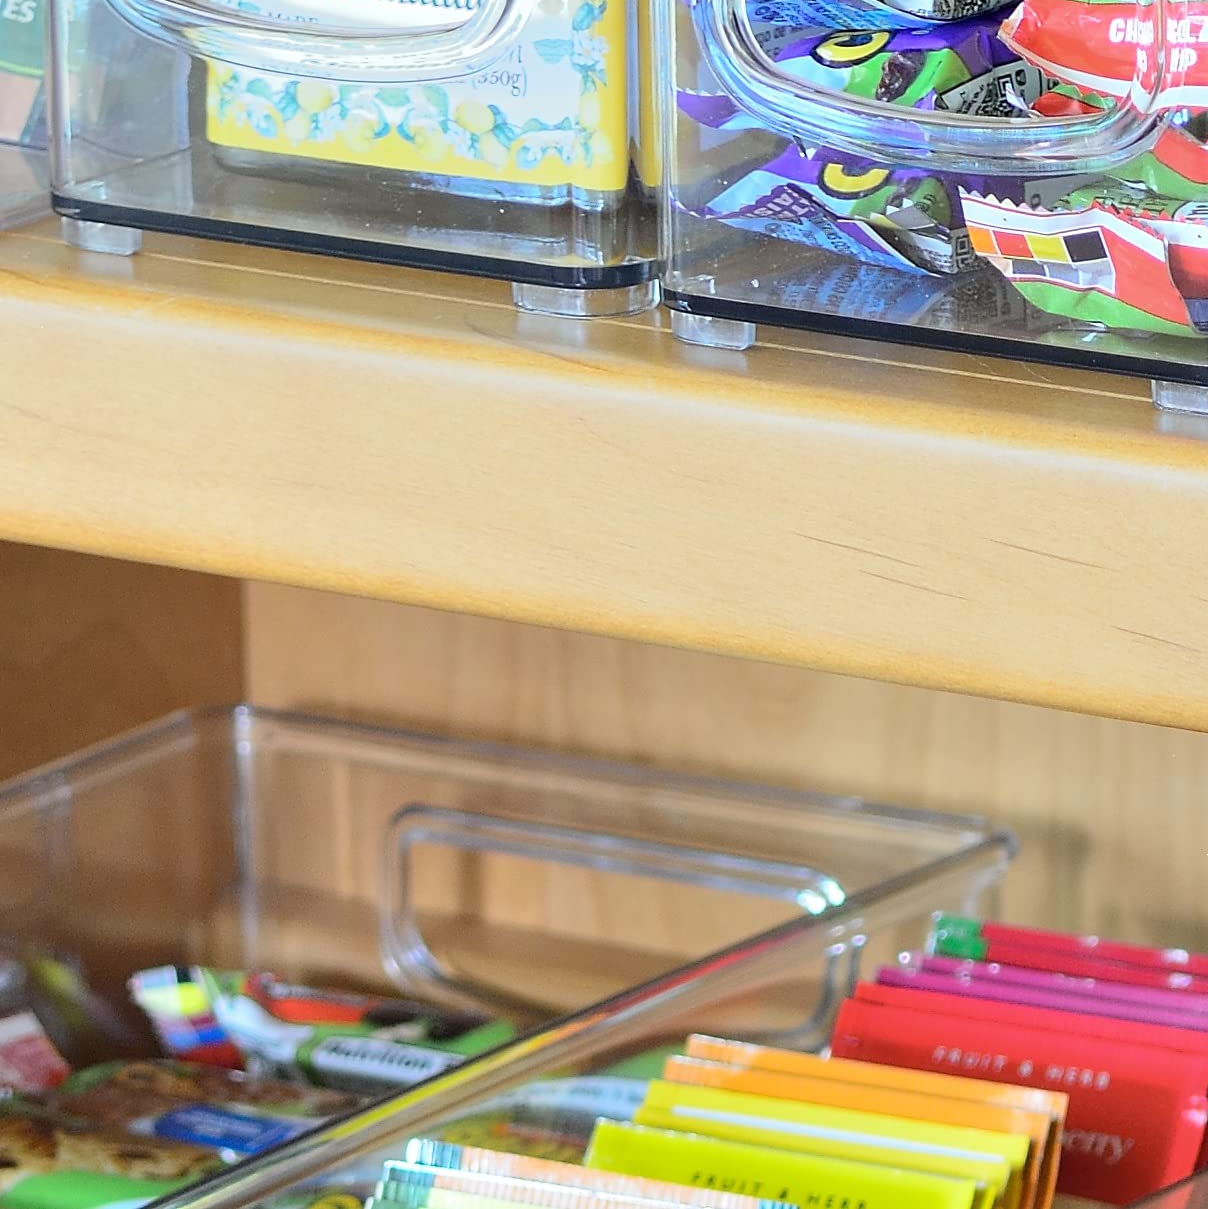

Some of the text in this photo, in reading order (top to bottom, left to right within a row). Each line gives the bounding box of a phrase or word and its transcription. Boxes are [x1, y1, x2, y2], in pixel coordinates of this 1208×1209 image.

[931, 1044, 1009, 1073] FRUIT
[1044, 1063, 1112, 1092] HERB
[691, 1169, 765, 1195] FRUIT
